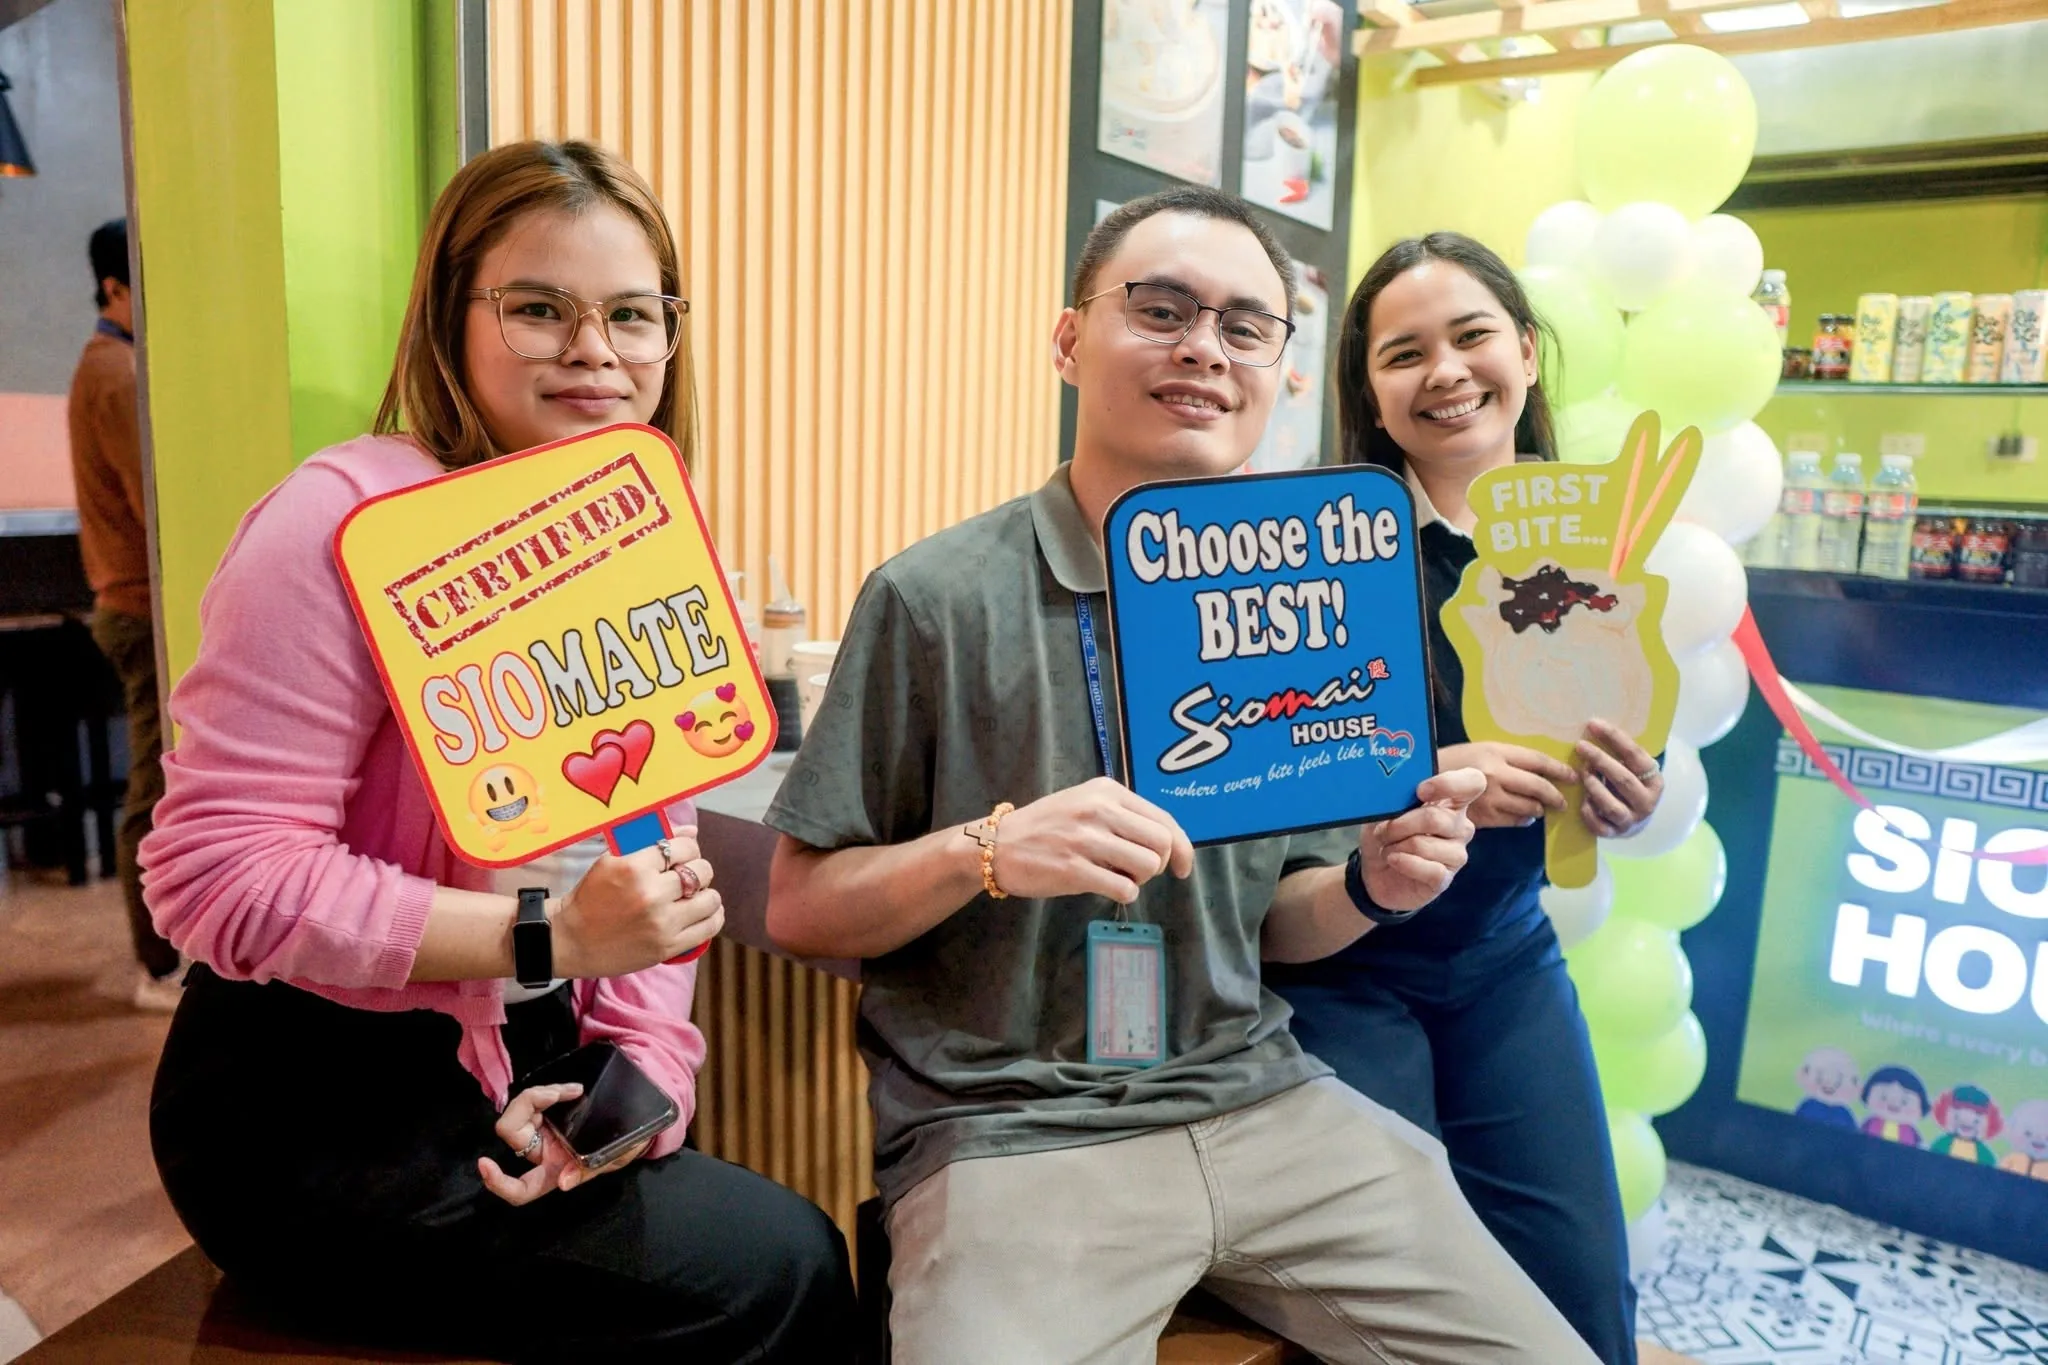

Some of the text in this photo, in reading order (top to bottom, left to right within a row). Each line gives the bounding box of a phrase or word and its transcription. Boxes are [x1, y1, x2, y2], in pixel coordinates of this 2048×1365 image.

[1489, 514, 1608, 552] BITE...
[1491, 473, 1609, 512] FIRST
[415, 483, 646, 629] CERTIFIED
[1126, 492, 1400, 584] Choose the
[1193, 578, 1349, 663] BEST!
[421, 584, 728, 766] SIOMATE
[1157, 668, 1375, 774] Siomai
[1291, 714, 1377, 746] HOUSE
[1223, 773, 1262, 794] every
[1267, 763, 1294, 783] bite
[1298, 753, 1332, 778] feels
[1337, 742, 1366, 763] like
[1369, 740, 1408, 758] home
[1829, 902, 2048, 1028] HO
[1861, 1009, 1940, 1043] where
[1947, 1031, 2023, 1066] every
